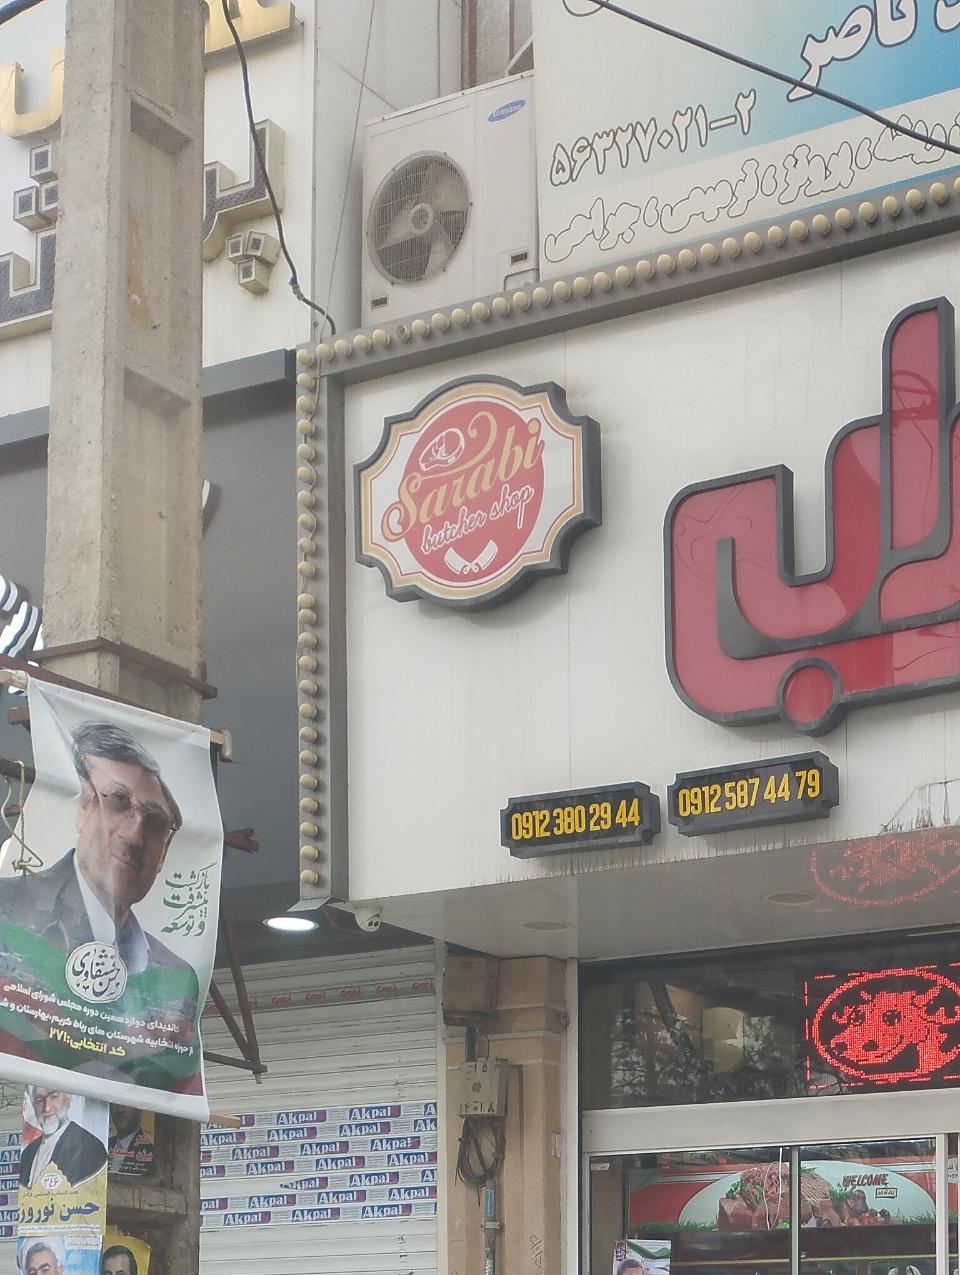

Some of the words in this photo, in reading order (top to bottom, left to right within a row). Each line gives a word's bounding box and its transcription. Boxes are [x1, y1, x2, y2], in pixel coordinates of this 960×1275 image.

[381, 411, 546, 543] Sarabi
[420, 507, 487, 555] butcher
[489, 484, 535, 530] shop
[678, 784, 722, 817] 0912
[725, 777, 760, 811] 587
[762, 772, 791, 804] 44
[794, 768, 821, 801] 79
[511, 812, 551, 841] 0912
[552, 805, 586, 835] 380
[589, 802, 612, 832] 29
[615, 798, 641, 828] 44
[108, 1045, 127, 1058] کد
[278, 1111, 317, 1125] Akpal
[350, 1106, 391, 1120] Akpal
[200, 1133, 237, 1146] Akpal
[269, 1128, 308, 1141] Akpal
[341, 1123, 381, 1137] Akpal
[233, 1147, 271, 1160] Akpal
[301, 1142, 340, 1155] Akpal
[372, 1138, 412, 1152] Akpal
[200, 1166, 217, 1177] pal
[248, 1162, 286, 1175] Akpal
[317, 1157, 356, 1171] Akpal
[388, 1153, 429, 1167] Akpal
[350, 1173, 390, 1187] Akpal
[842, 1173, 889, 1188] WELCOME
[201, 1199, 220, 1210] pal
[250, 1195, 287, 1208] Akpal
[318, 1191, 357, 1205] Akpal
[389, 1188, 429, 1201] Akpal
[60, 1202, 100, 1222] حسن
[225, 1213, 262, 1226] Akpal
[291, 1209, 331, 1222] Akpal
[363, 1205, 402, 1219] Akpal
